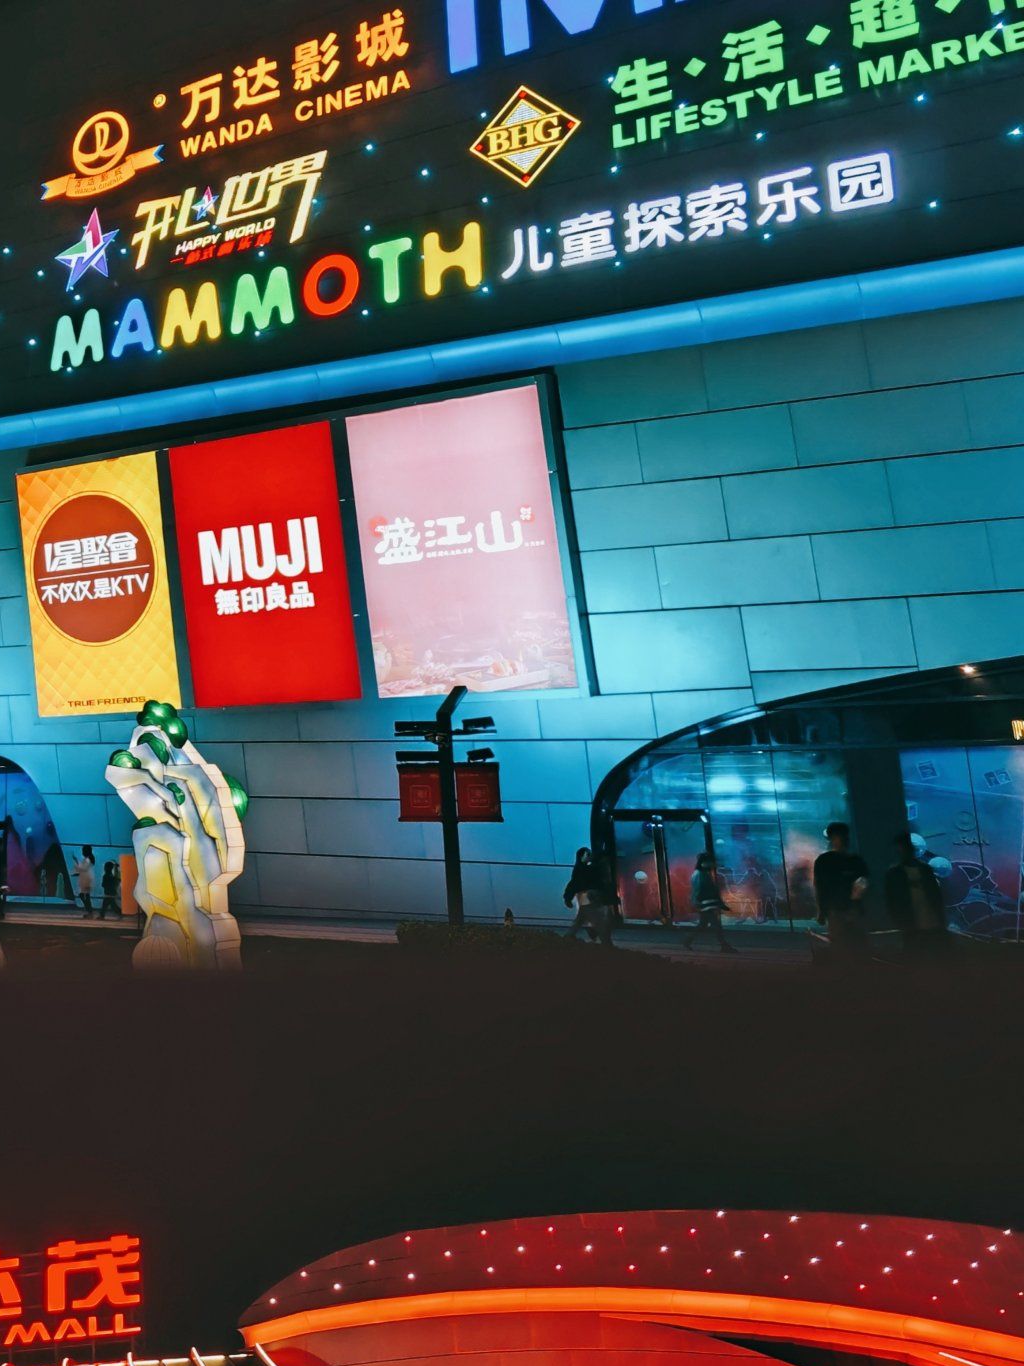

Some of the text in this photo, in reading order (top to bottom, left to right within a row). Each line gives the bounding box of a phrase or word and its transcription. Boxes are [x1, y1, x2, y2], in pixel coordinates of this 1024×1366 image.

[180, 9, 410, 129] 万达影城
[180, 70, 411, 158] WANDA CINEMA
[612, 66, 845, 150] LIFESTYLE
[486, 113, 562, 159] BHG
[175, 217, 276, 256] HAPPY WORLD
[500, 151, 895, 281] 儿童探索乐园
[50, 221, 483, 372] MAMMOTH
[197, 515, 323, 586] MUJI
[374, 510, 524, 565] 盛江山
[41, 573, 150, 605] 不仅仅是KTV
[214, 580, 316, 616] 無印良品
[67, 695, 147, 709] TRUE FRIENDS
[4, 1312, 142, 1346] MALL
